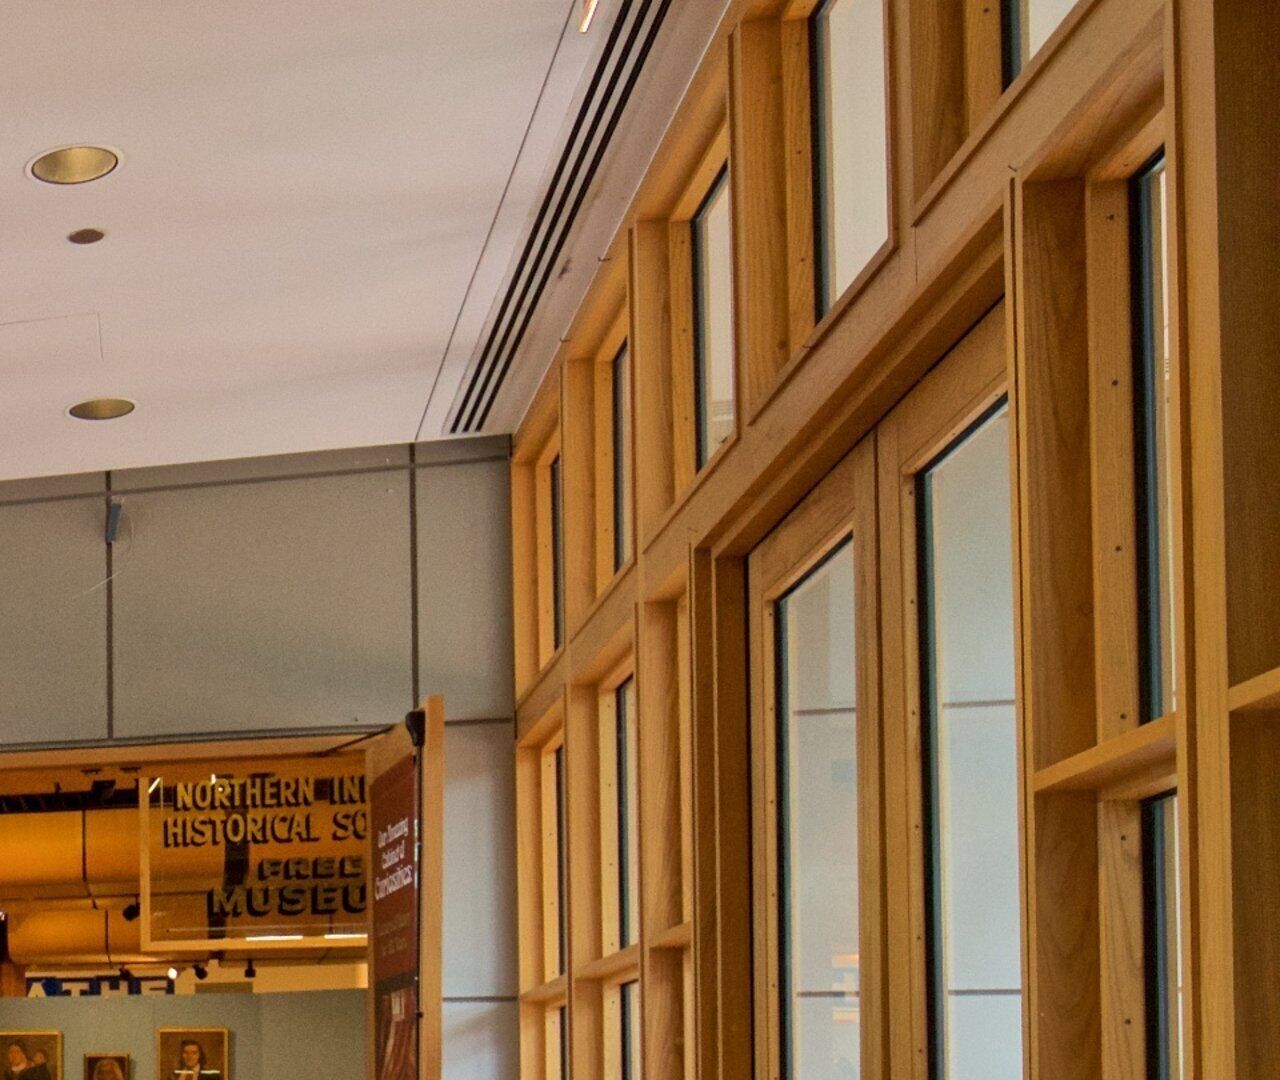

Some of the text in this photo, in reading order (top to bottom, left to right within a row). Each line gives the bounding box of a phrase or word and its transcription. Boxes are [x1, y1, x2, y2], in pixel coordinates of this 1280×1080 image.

[173, 774, 313, 811] NORTHERN
[163, 811, 321, 848] HISTORICAL
[256, 856, 363, 881] FREE
